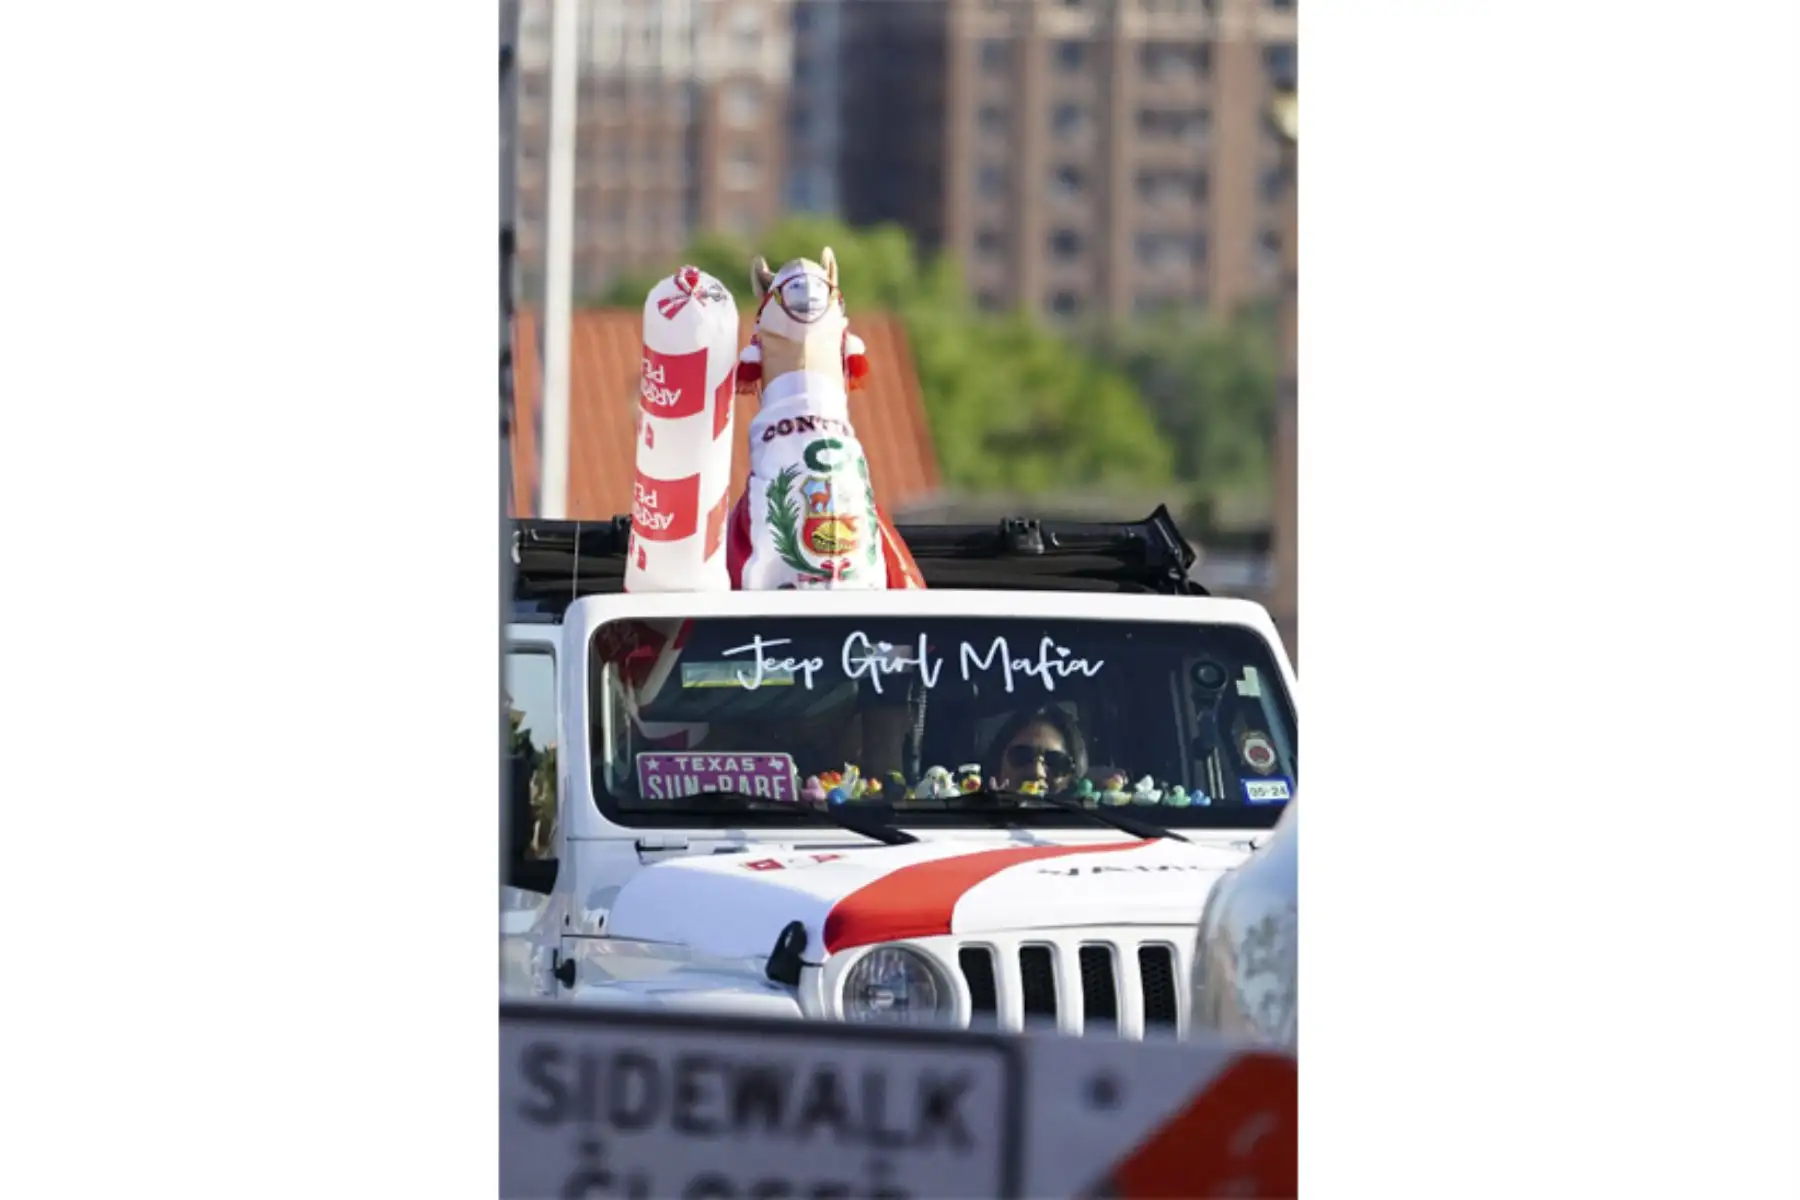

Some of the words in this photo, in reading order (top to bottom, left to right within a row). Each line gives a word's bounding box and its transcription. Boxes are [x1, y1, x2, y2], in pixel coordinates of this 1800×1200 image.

[721, 634, 824, 690] Jeep
[842, 631, 943, 694] Girl
[960, 636, 1104, 693] Mafia
[675, 757, 755, 772] TEXAS
[517, 1040, 976, 1154] SIDEWALK
